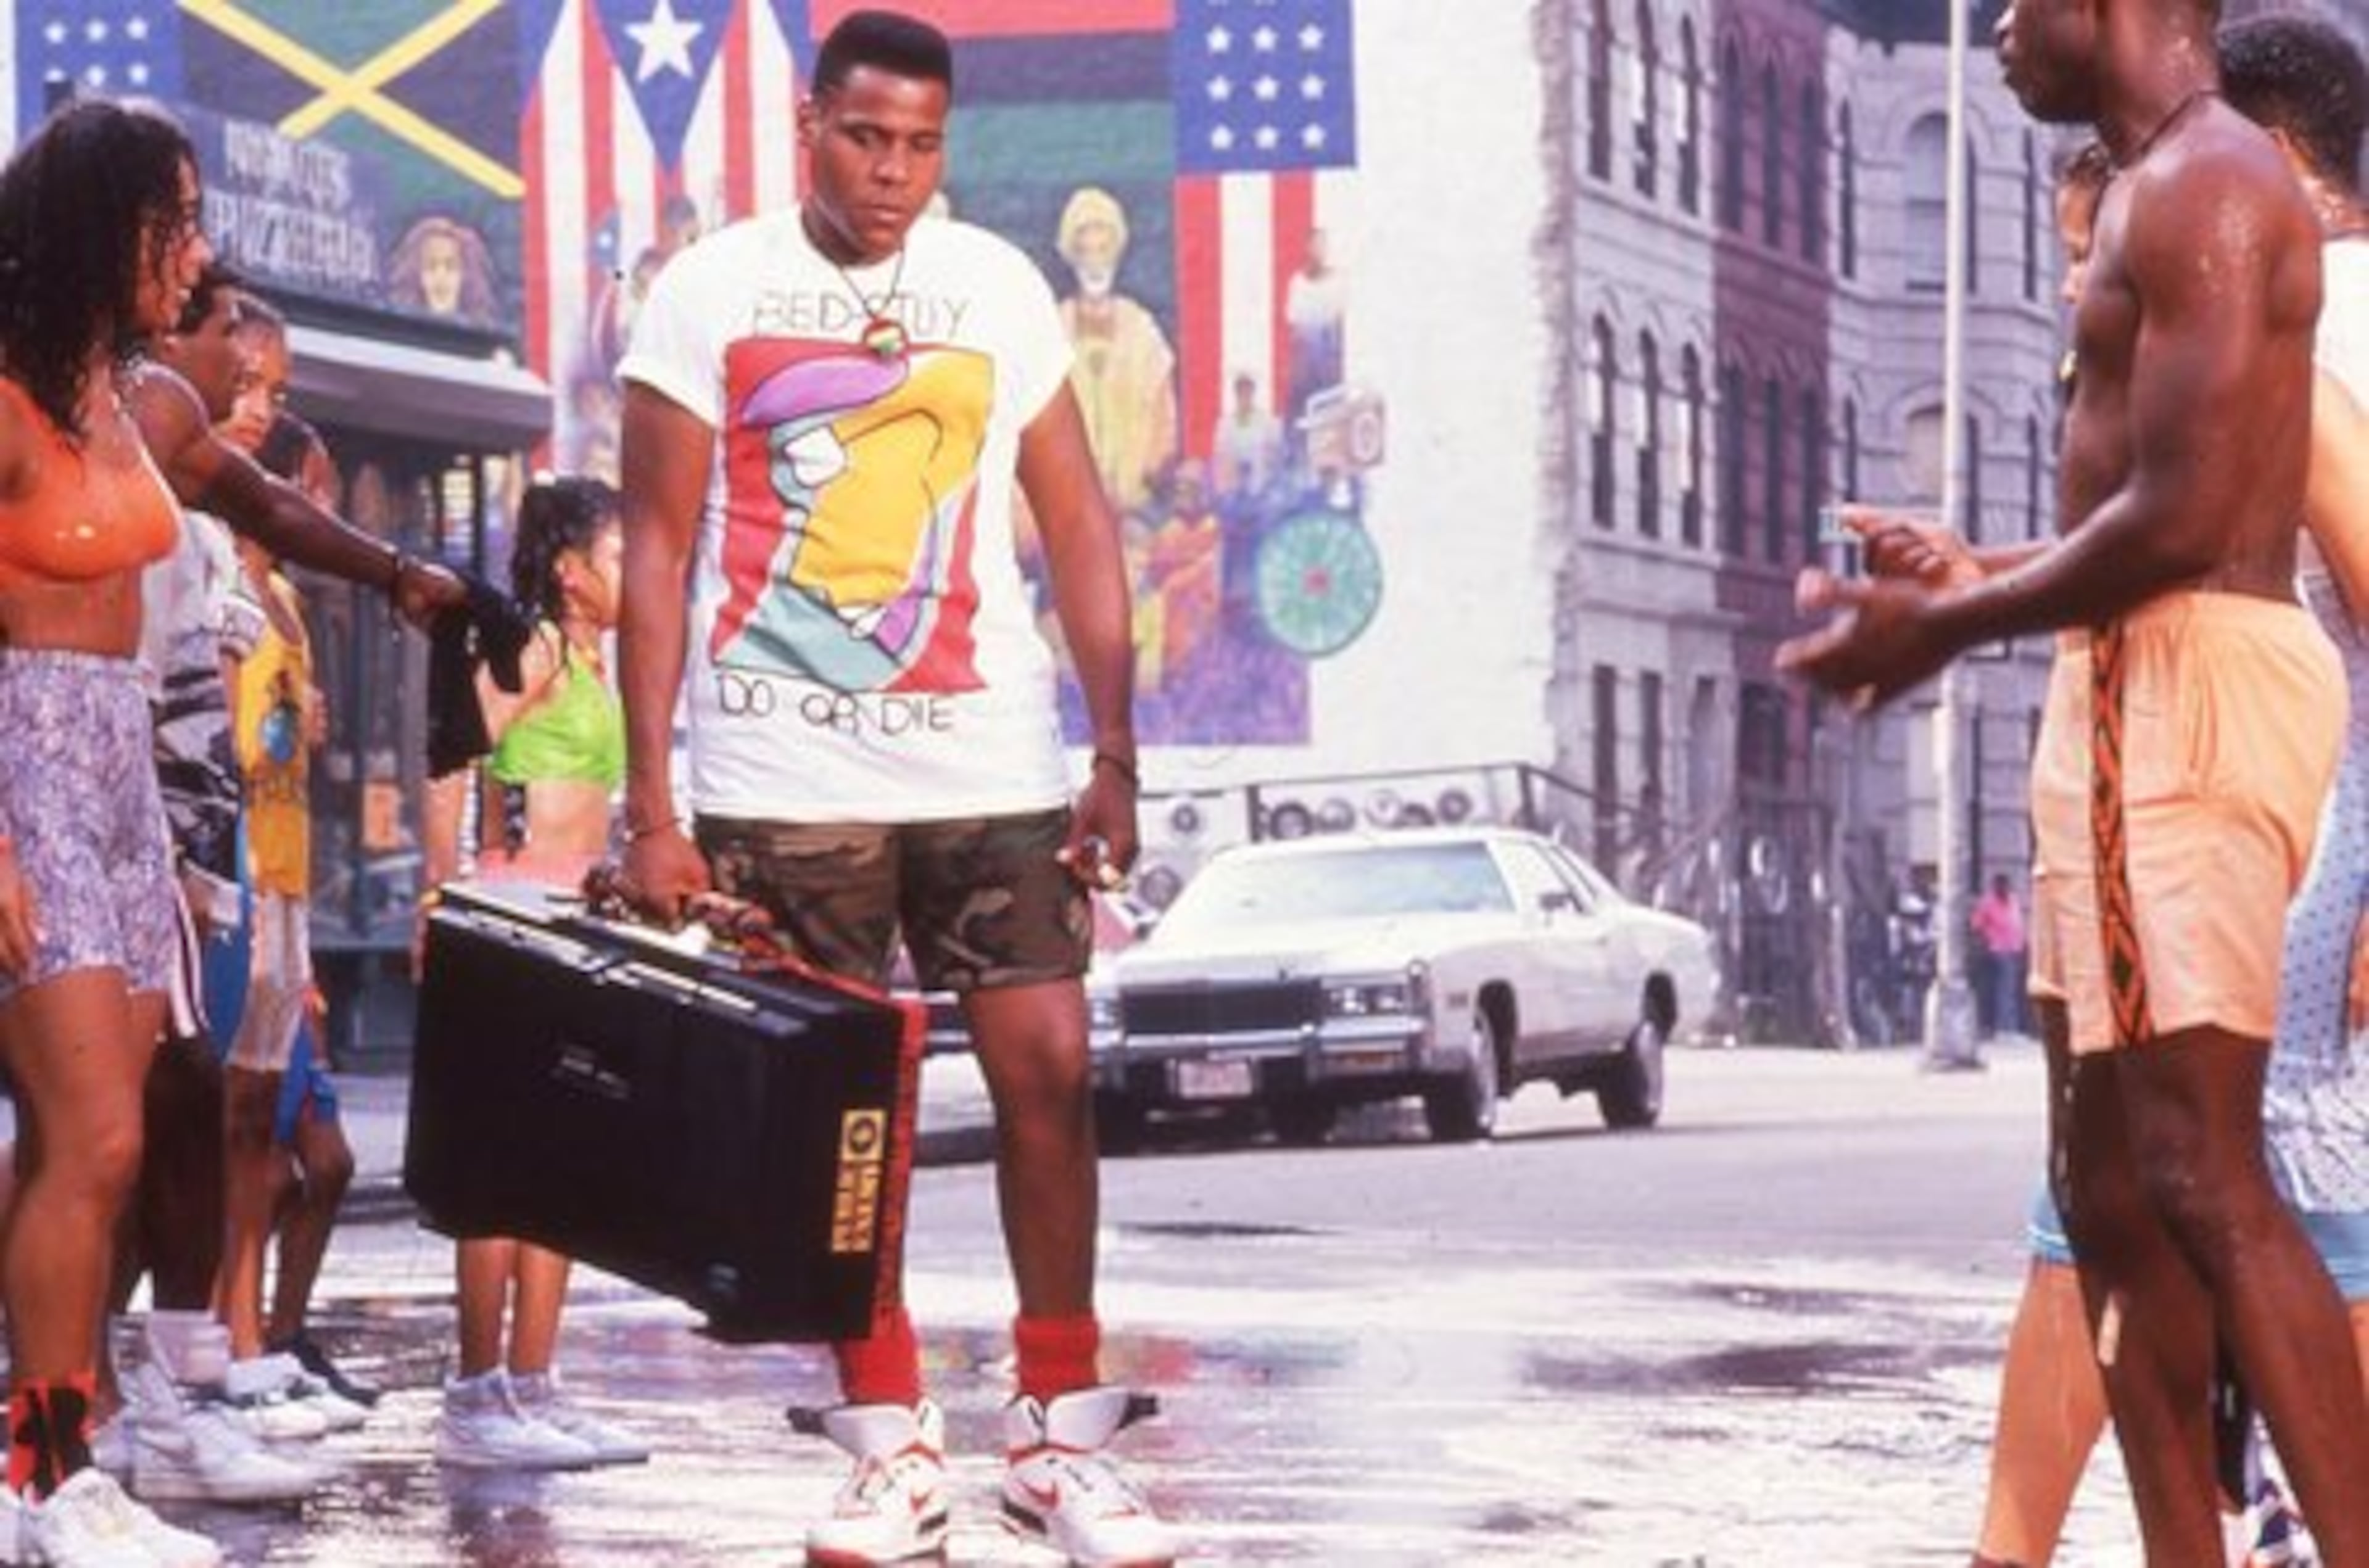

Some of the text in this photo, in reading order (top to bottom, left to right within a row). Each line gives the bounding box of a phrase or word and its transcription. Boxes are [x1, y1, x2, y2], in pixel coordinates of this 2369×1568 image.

[716, 673, 955, 736] DO OR DIE
